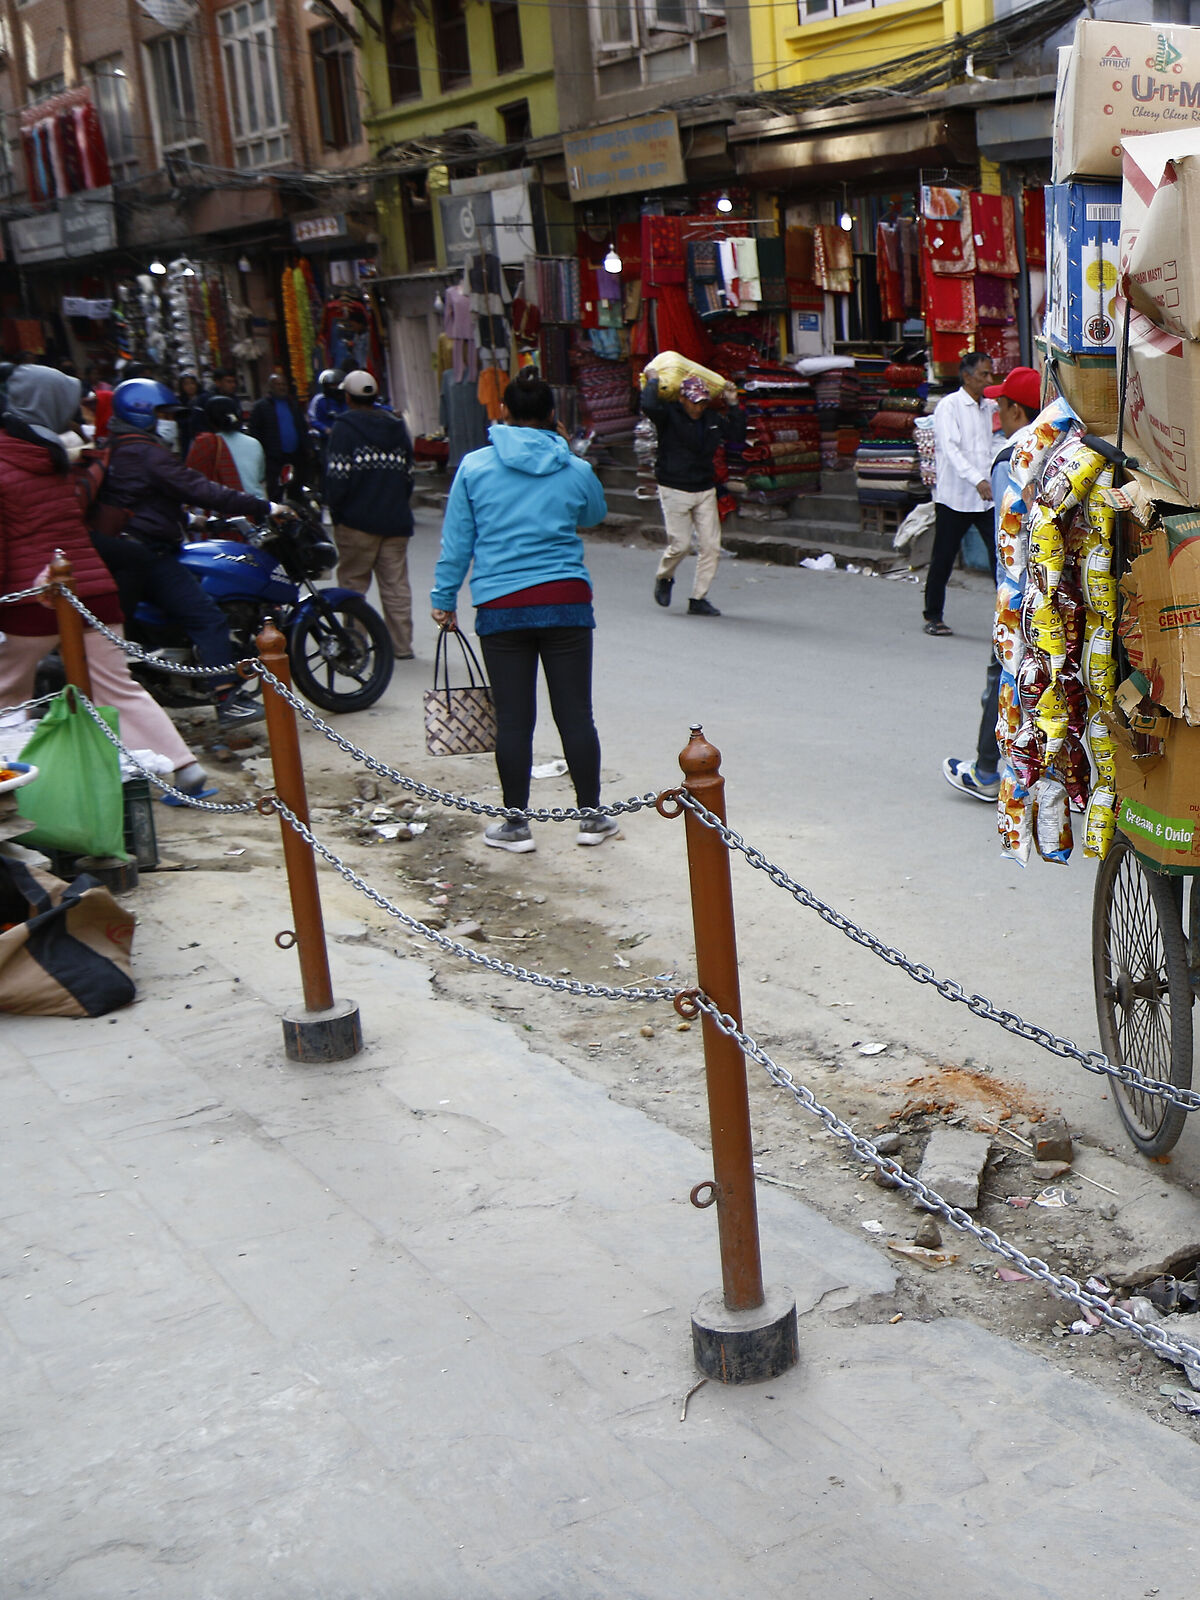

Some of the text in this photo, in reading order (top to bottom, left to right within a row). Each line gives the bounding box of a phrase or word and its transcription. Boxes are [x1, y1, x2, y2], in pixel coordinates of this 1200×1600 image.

[1099, 57, 1131, 69] amudi
[1125, 807, 1155, 833] Cream
[1154, 822, 1164, 837] &
